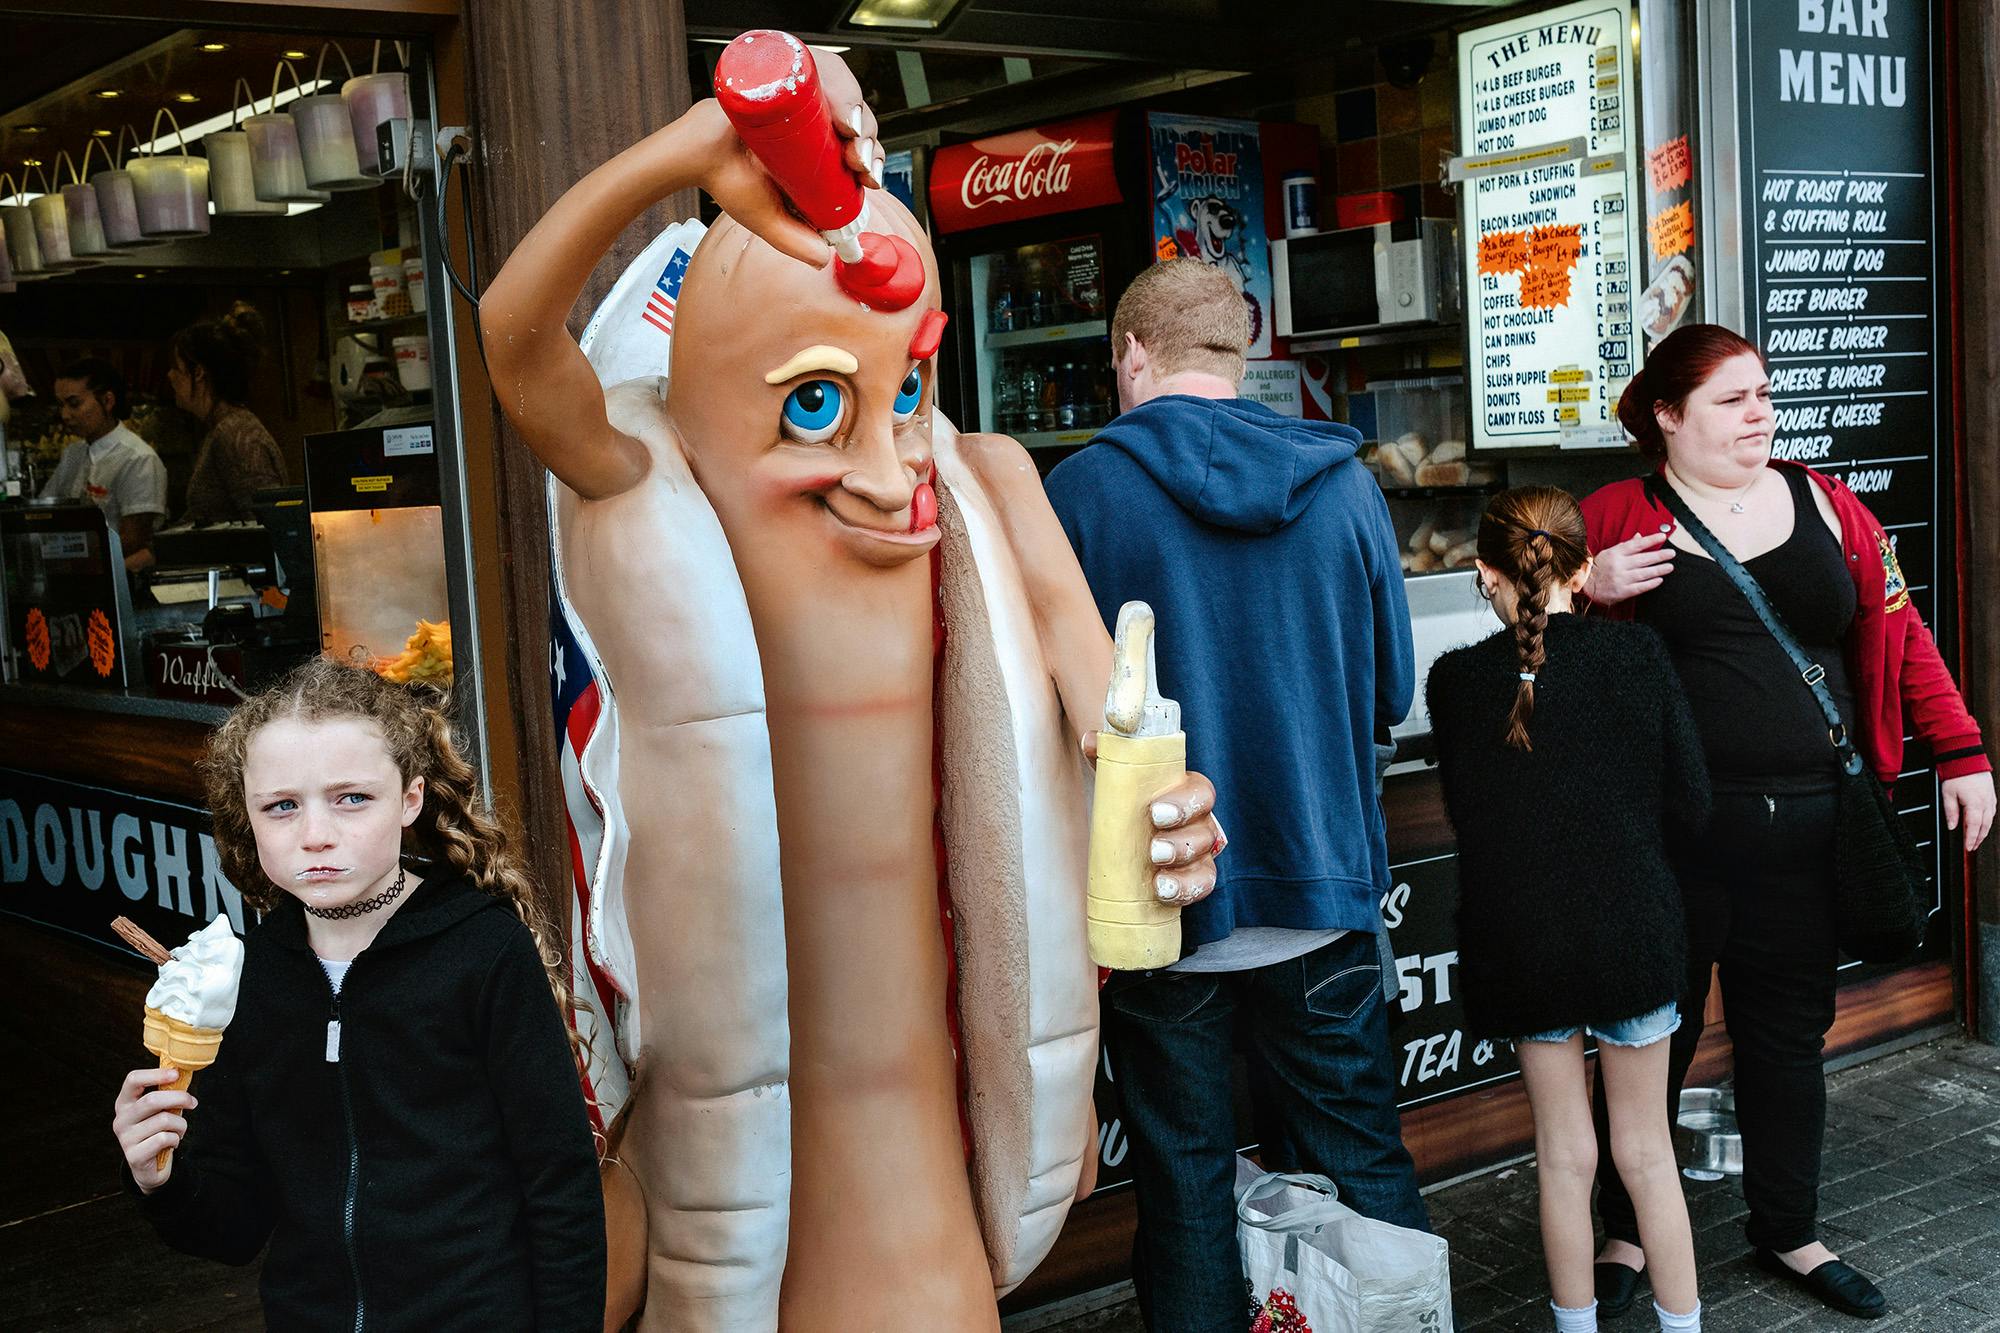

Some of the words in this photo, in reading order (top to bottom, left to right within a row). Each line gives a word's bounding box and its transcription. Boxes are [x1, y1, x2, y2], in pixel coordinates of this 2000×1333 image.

[1798, 0, 1889, 38] BAR
[1487, 34, 1530, 69] THE
[1538, 25, 1602, 47] MENU
[1490, 76, 1500, 92] LB
[1503, 71, 1523, 89] BEEF
[1526, 62, 1562, 85] BURGER
[1588, 54, 1595, 69] £
[1779, 48, 1906, 107] MENU
[1490, 96, 1501, 112] LB
[1503, 90, 1536, 110] CHEESE
[1539, 80, 1575, 102] BURGER
[1589, 74, 1596, 89] £
[1477, 115, 1507, 134] JUMBO
[1508, 111, 1526, 128] HOT
[1528, 106, 1547, 125] DOG
[1590, 96, 1596, 110] £
[1599, 97, 1619, 111] 2.50
[1477, 138, 1495, 154] HOT
[1497, 133, 1514, 150] DOG
[1591, 117, 1597, 131] £
[1600, 116, 1619, 131] 1.00
[1175, 138, 1238, 177] Polar
[1178, 172, 1240, 200] KRUSH
[1479, 175, 1497, 193] HOT
[1499, 171, 1521, 190] PORK
[1524, 170, 1530, 186] &
[1532, 163, 1575, 185] STUFFING
[1762, 179, 1794, 203] HOT
[1796, 179, 1845, 203] ROAST
[1846, 180, 1889, 204] PORK
[1529, 184, 1576, 205] SANDWICH
[1593, 200, 1600, 214] £
[1603, 199, 1624, 214] 2.40
[1481, 215, 1509, 233] BACON
[1511, 208, 1557, 227] SANDWICH
[1594, 221, 1600, 235] £
[1549, 227, 1579, 239] Cheese
[1764, 209, 1776, 232] &
[1781, 209, 1850, 233] STUFFING
[1853, 210, 1887, 233] ROLL
[1533, 243, 1559, 259] Burger
[1765, 249, 1821, 273] JUMBO
[1822, 248, 1853, 272] HOT
[1853, 248, 1885, 272] DOG
[1483, 277, 1499, 291] TEA
[1596, 262, 1602, 276] £
[1484, 294, 1514, 310] COFFEE
[1596, 282, 1602, 296] £
[1766, 289, 1806, 313] BEEF
[1808, 287, 1868, 312] BURGER
[1484, 315, 1501, 330] HOT
[1504, 310, 1554, 326] CHOCOLATE
[1597, 303, 1603, 317] £
[1485, 334, 1501, 348] CAN
[1504, 331, 1536, 346] DRINKS
[1598, 324, 1604, 337] £
[1610, 323, 1631, 335] 1.20
[1767, 327, 1829, 353] DOUBLE
[1829, 326, 1888, 352] BURGER
[1486, 354, 1511, 368] CHIPS
[1605, 342, 1626, 358] 2.00
[1255, 369, 1296, 380] ALLERGIES
[1260, 382, 1271, 390] and
[1487, 372, 1513, 388] SLUSH
[1516, 370, 1547, 385] PUPPIE
[1599, 365, 1605, 379] £
[1610, 364, 1629, 376] 3.00
[1770, 366, 1826, 393] CHEESE
[1827, 364, 1886, 390] BURGER
[1487, 392, 1520, 407] DONUTS
[1600, 386, 1606, 399] £
[1488, 411, 1515, 427] CANDY
[1518, 410, 1545, 424] FLOSS
[1600, 405, 1607, 419] £
[1773, 405, 1831, 432] DOUBLE
[1832, 403, 1885, 428] CHEESE
[1771, 435, 1833, 460] BURGER
[1847, 469, 1893, 493] BACON
[159, 652, 236, 696] Waffle
[0, 798, 245, 935] DOUGHN
[1401, 1029, 1462, 1087] TEA
[1472, 1038, 1495, 1066] &
